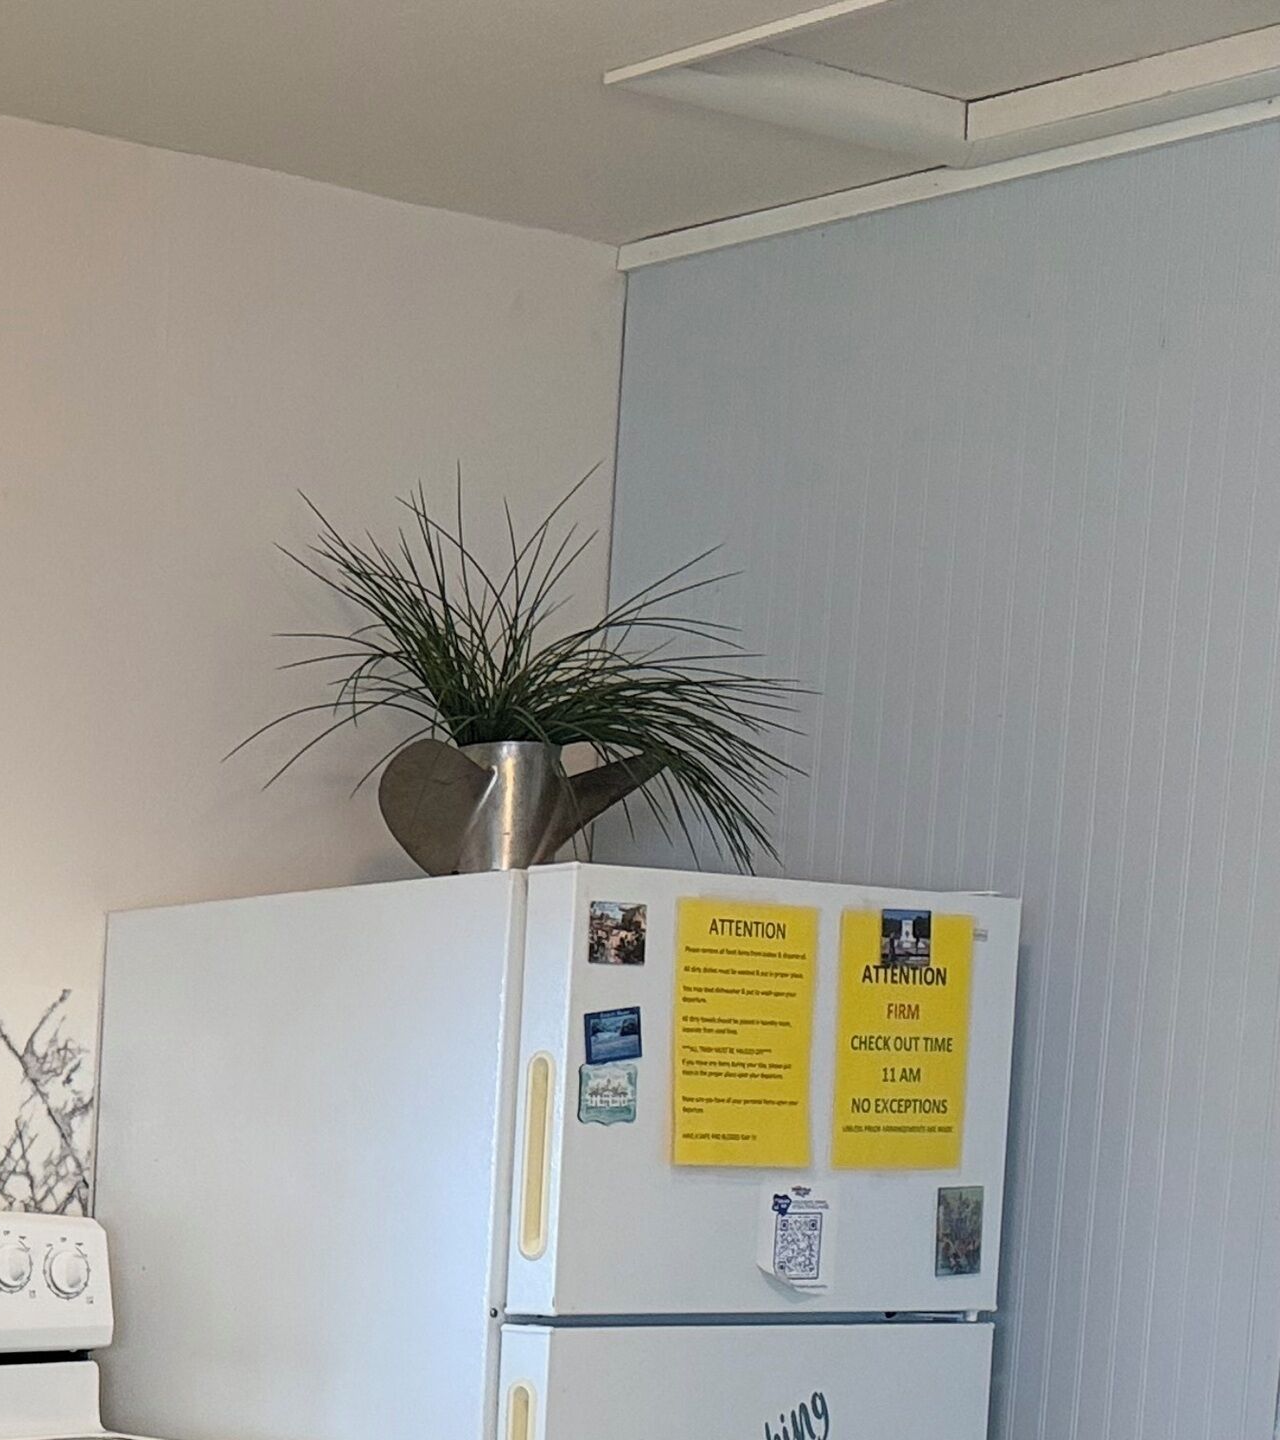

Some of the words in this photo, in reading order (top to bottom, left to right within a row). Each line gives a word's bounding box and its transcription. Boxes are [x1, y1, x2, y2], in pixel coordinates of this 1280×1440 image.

[708, 918, 787, 940] ATTENTION
[861, 965, 947, 986] ATTENTION
[886, 1003, 920, 1021] FIRM
[850, 1034, 893, 1052] CHECK
[895, 1036, 921, 1052] OUT
[923, 1037, 953, 1053] TIME
[882, 1067, 896, 1082] 11
[898, 1067, 921, 1083] AM
[851, 1097, 871, 1115] NO
[874, 1097, 948, 1115] EXCEPTIONS
